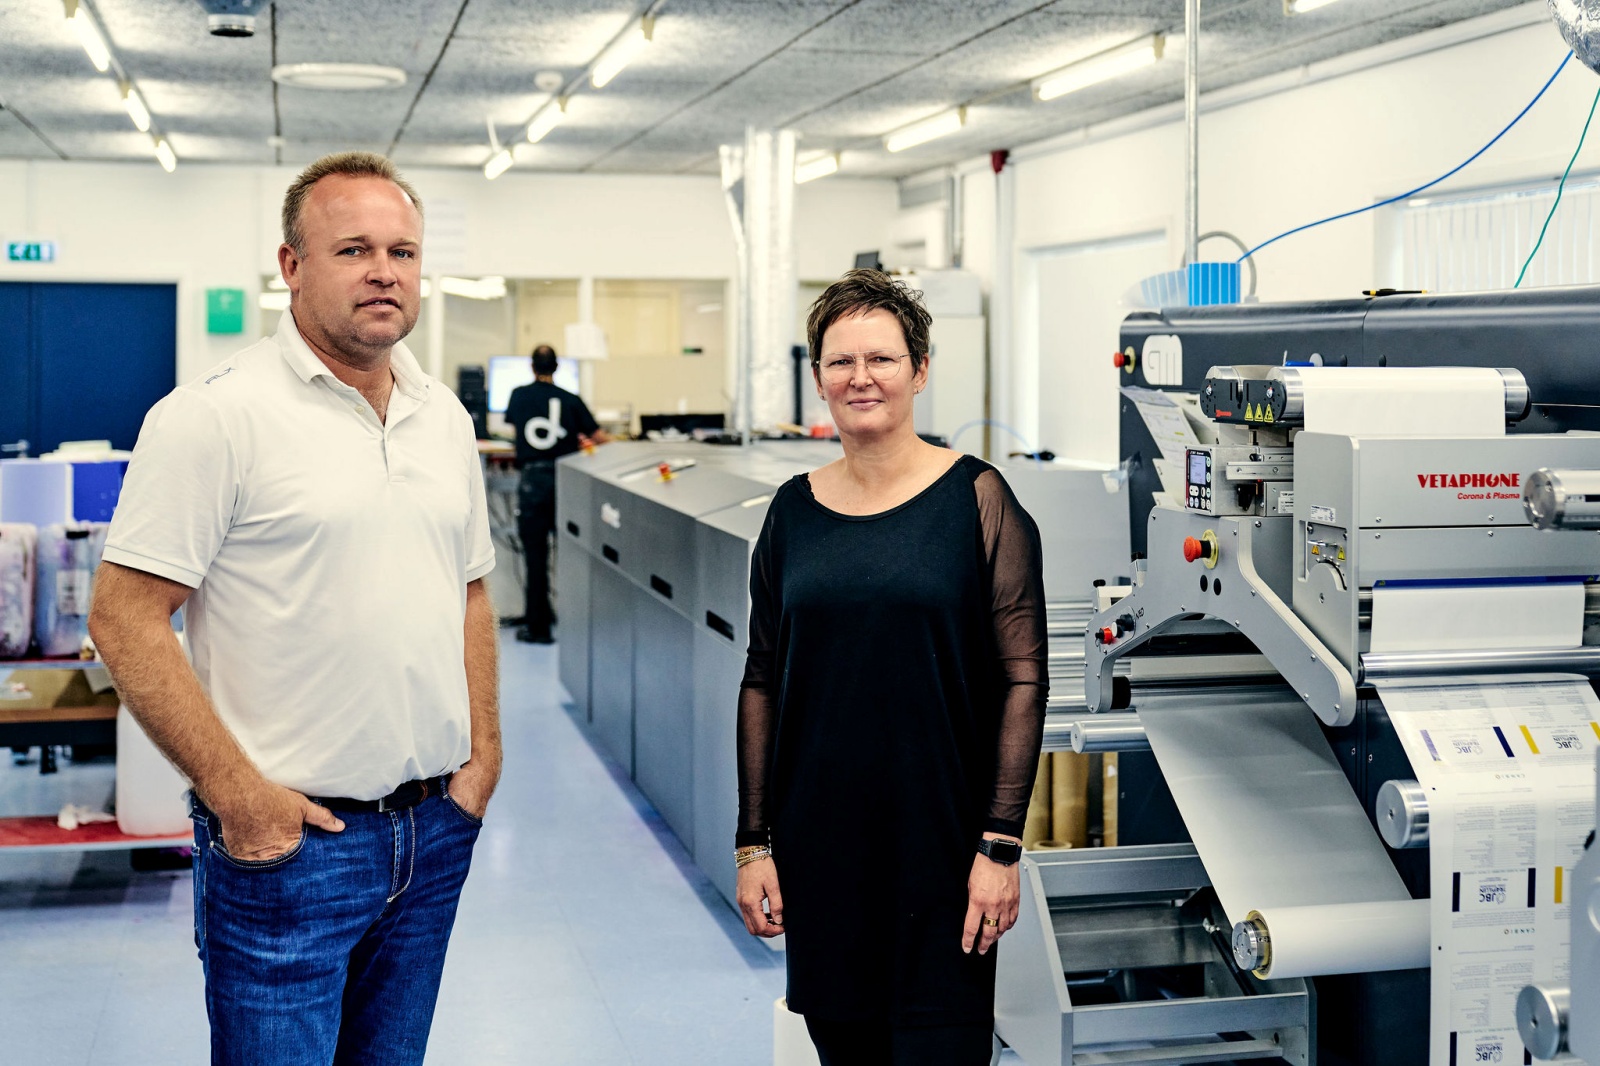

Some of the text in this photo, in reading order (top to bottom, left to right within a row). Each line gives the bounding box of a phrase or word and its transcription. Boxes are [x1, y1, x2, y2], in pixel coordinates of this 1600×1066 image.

[1417, 473, 1520, 488] VETAPHONE
[1457, 492, 1484, 500] Corona
[1493, 491, 1520, 499] Plasma
[1478, 892, 1497, 903] JBC
[1475, 1051, 1493, 1062] JBC
